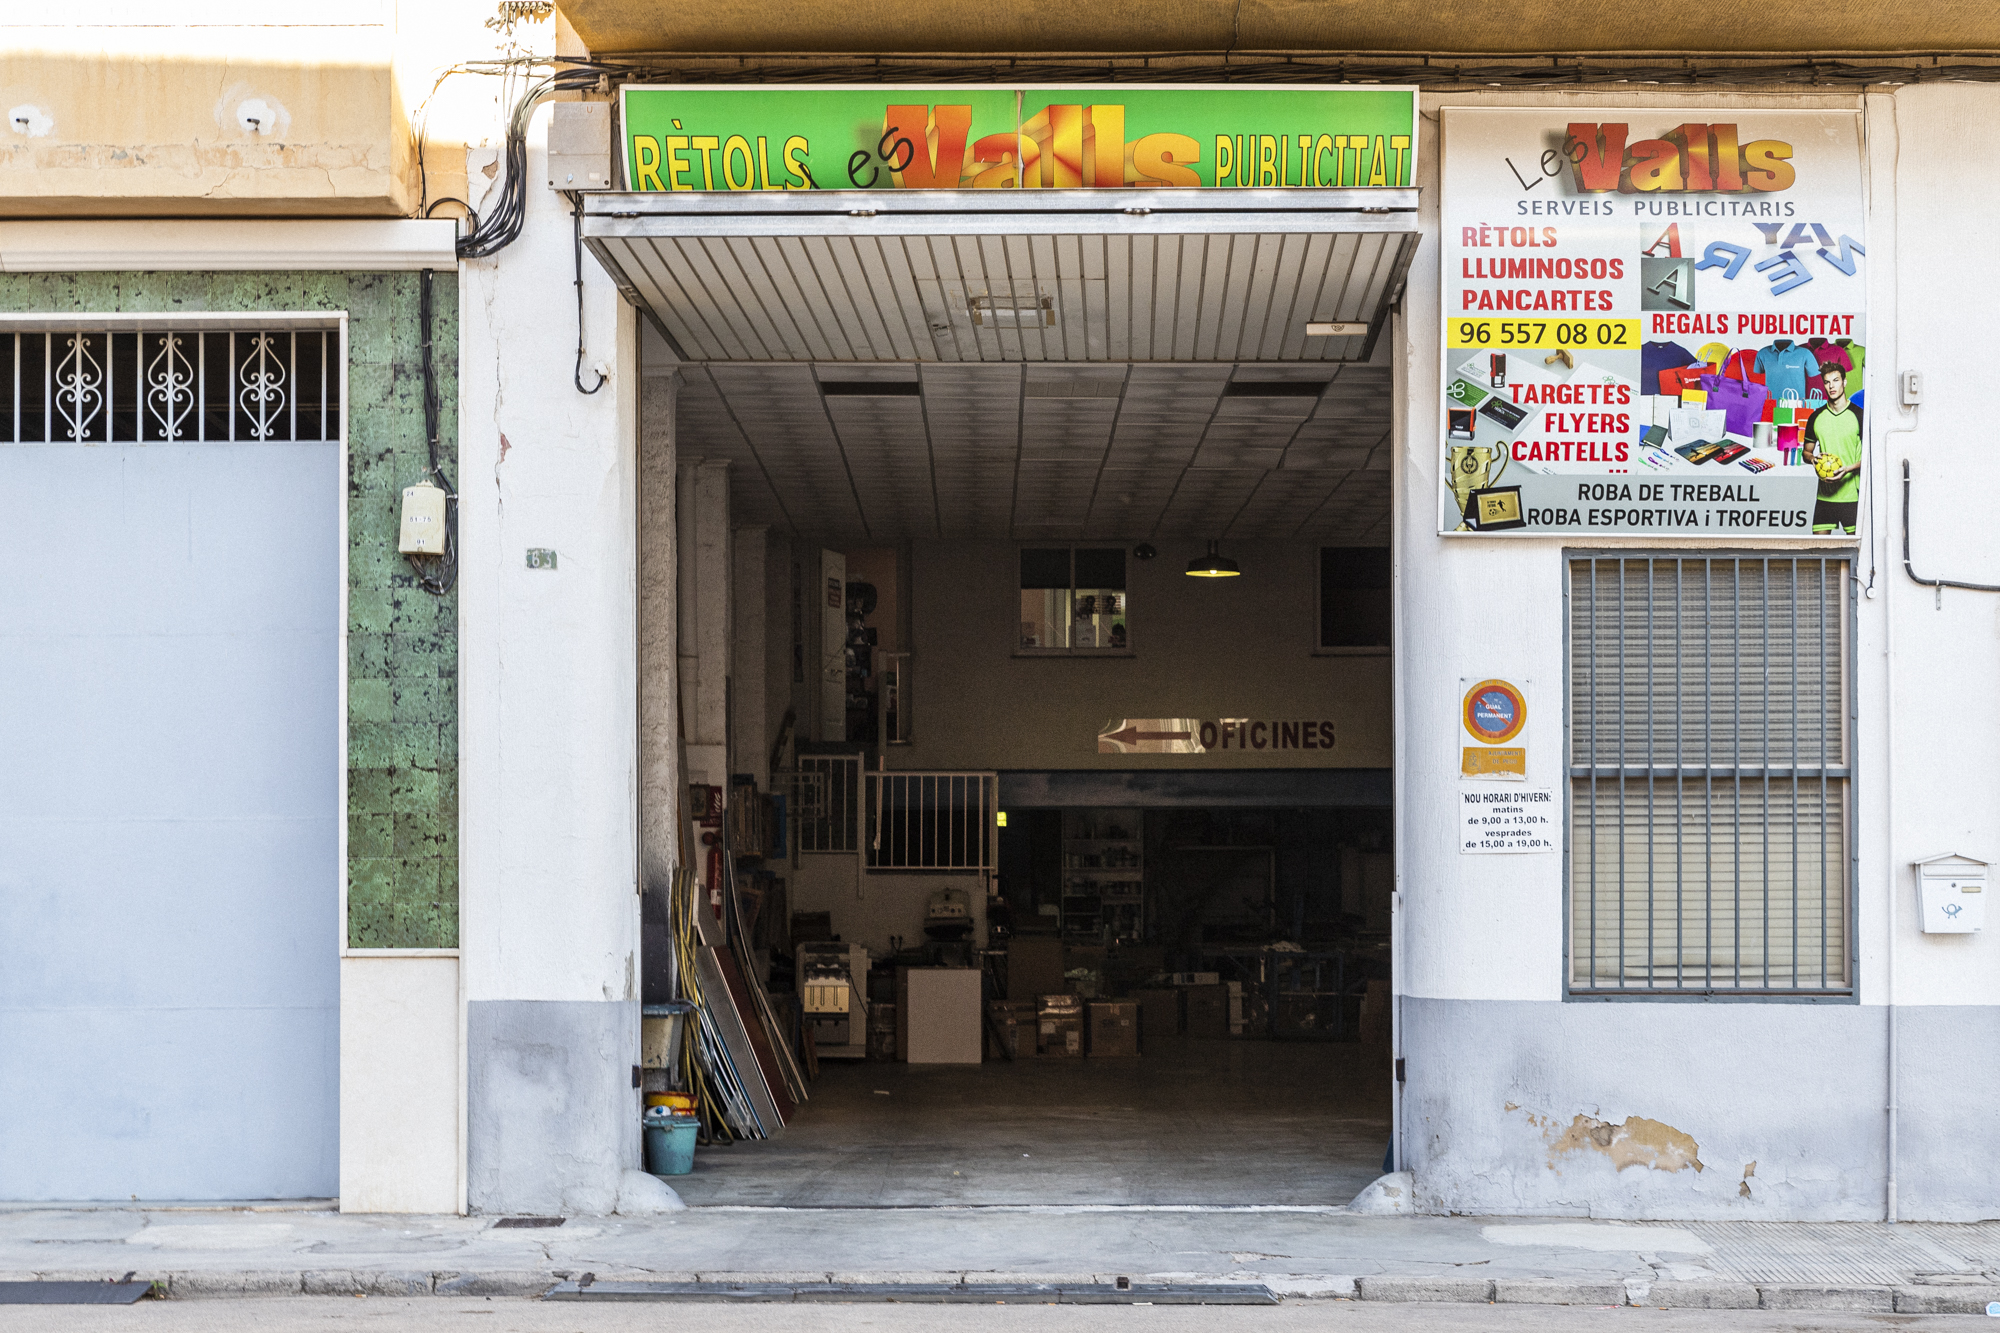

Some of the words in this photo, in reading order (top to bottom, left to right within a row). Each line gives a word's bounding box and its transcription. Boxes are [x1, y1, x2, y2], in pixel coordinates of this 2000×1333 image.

[633, 118, 812, 191] RÈTOLS
[881, 104, 1201, 188] Valls
[1215, 133, 1410, 187] PUBLICITAT
[1505, 134, 1590, 191] Les
[1565, 122, 1796, 194] Valls
[1517, 200, 1614, 216] SERVEIS
[1634, 200, 1796, 217] PUBLICITARIS
[1462, 222, 1558, 248] RÈTOLS
[1462, 257, 1624, 280] LLUMINOSOS
[1462, 289, 1613, 312] PANCARTES
[1460, 322, 1491, 345] 96
[1500, 322, 1547, 345] 557
[1556, 323, 1588, 345] 08
[1596, 323, 1627, 345] 02
[1652, 313, 1729, 335] REGALS
[1738, 314, 1855, 336] PUBLICITAT
[1508, 383, 1631, 406] TARGETES
[1545, 412, 1630, 434] FLYERS
[1511, 441, 1629, 463] CARTELLS
[1578, 483, 1633, 502] ROBA
[1639, 484, 1664, 502] DE
[1672, 484, 1760, 503] TREBALL
[1527, 508, 1582, 527] ROBA
[1588, 508, 1699, 527] ESPORTIVA
[1704, 508, 1711, 527] i
[1718, 509, 1807, 528] TROFEUS
[1200, 720, 1335, 749] OFICINES
[1464, 793, 1481, 803] NOU
[1483, 792, 1512, 803] HORARI
[1514, 792, 1552, 803] D'HIVERN:
[1492, 805, 1524, 813] matins
[1467, 817, 1479, 825] de
[1481, 816, 1502, 826] 9,00
[1513, 816, 1538, 825] 13,00
[1540, 816, 1549, 824] h.
[1465, 840, 1477, 848] de
[1479, 839, 1505, 849] 15,00
[1516, 839, 1541, 849] 19,00
[1485, 829, 1532, 838] vesprades
